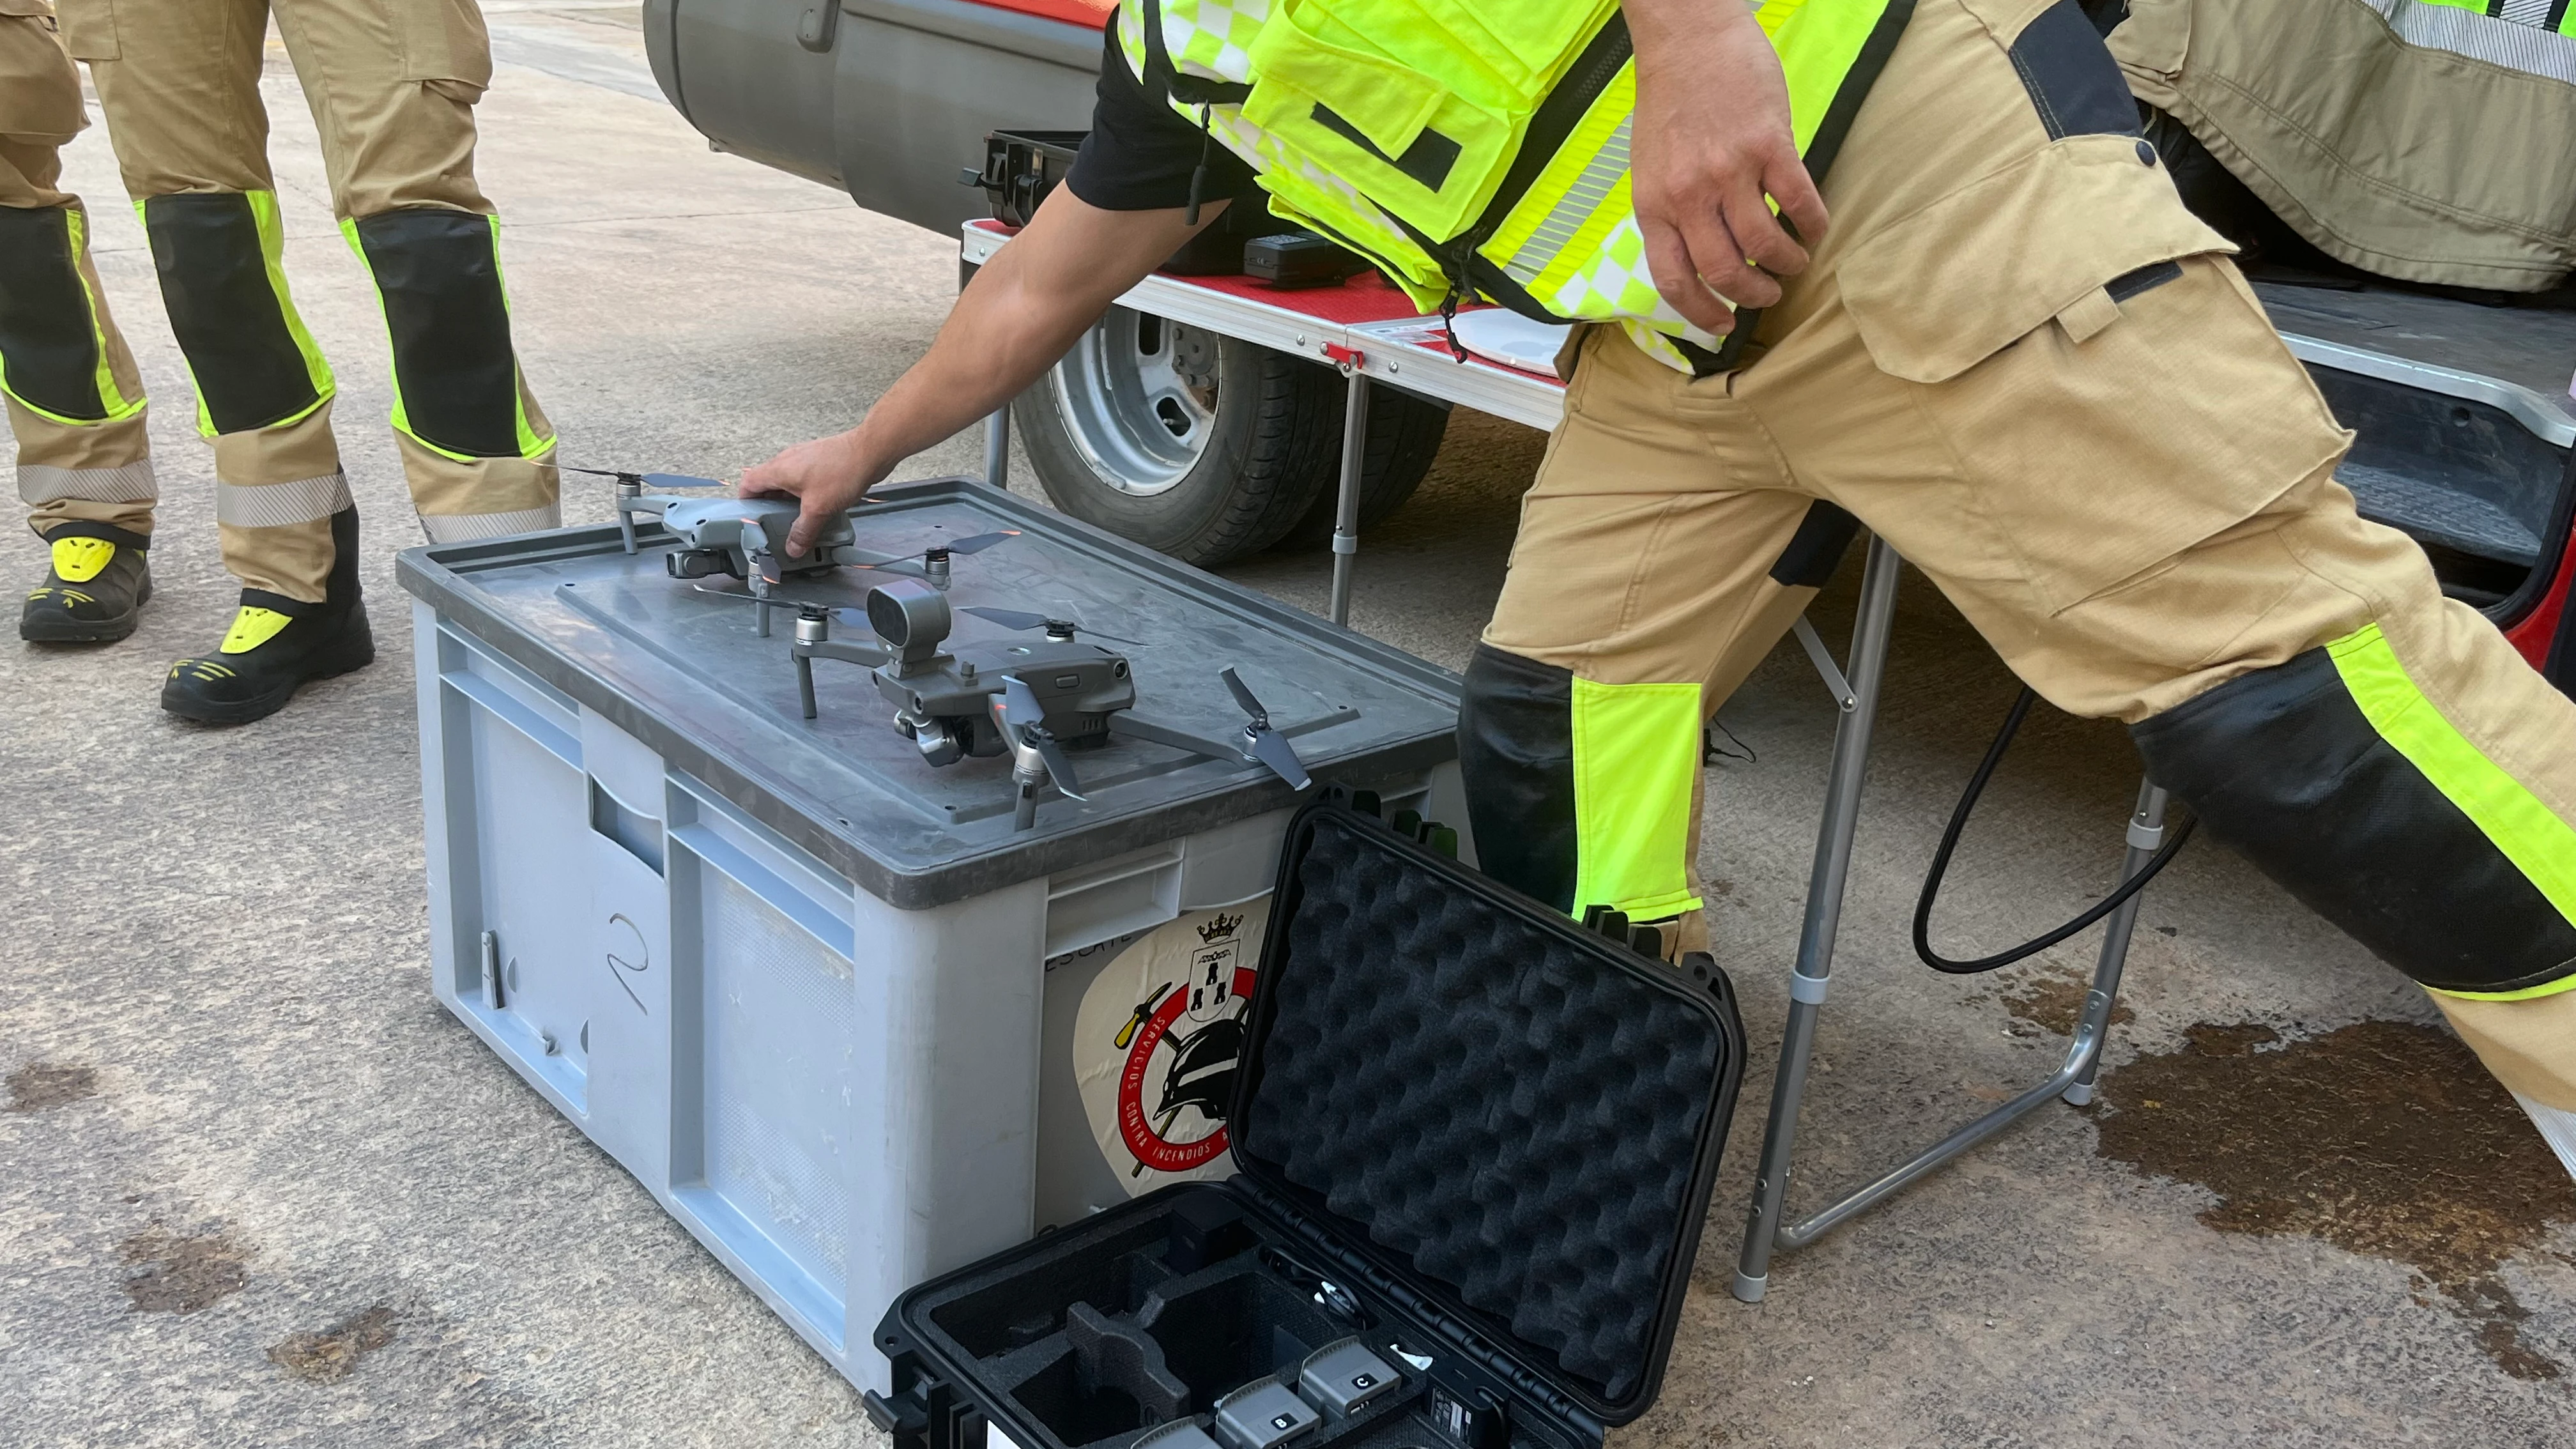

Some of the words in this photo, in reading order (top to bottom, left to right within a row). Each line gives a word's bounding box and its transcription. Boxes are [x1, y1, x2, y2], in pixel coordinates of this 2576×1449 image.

[607, 912, 649, 1016] 2
[1128, 1016, 1165, 1090] SERVICIOS
[1126, 1101, 1148, 1147] CONTRA
[1153, 1142, 1211, 1162] INCENDIOS
[1356, 1377, 1368, 1387] C
[1275, 1418, 1287, 1429] B
